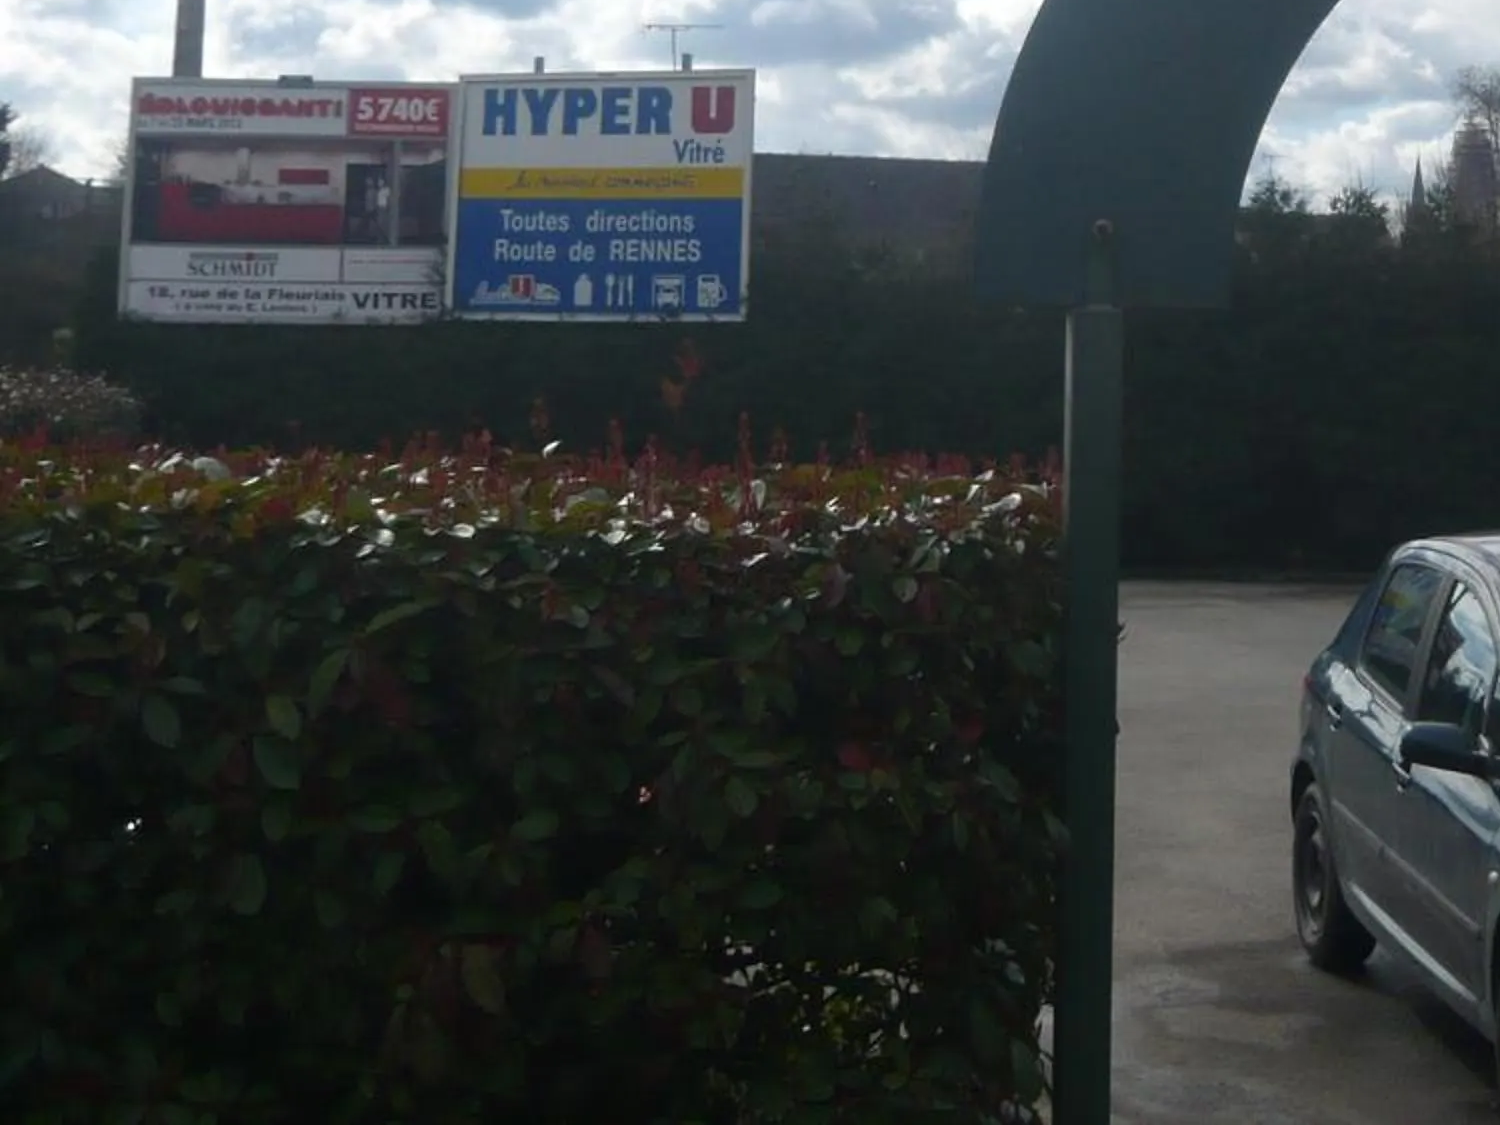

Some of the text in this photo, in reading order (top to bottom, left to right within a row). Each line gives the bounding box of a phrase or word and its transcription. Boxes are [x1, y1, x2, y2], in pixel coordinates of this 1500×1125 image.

[482, 86, 735, 136] HYPER U
[673, 138, 725, 164] Vitré
[500, 209, 696, 232] Toutes directions
[494, 239, 702, 263] Route de RENNES
[186, 260, 277, 277] SCHMIDT
[181, 288, 210, 299] rue
[216, 287, 239, 300] de
[244, 288, 262, 300] la
[352, 292, 437, 310] VITRE
